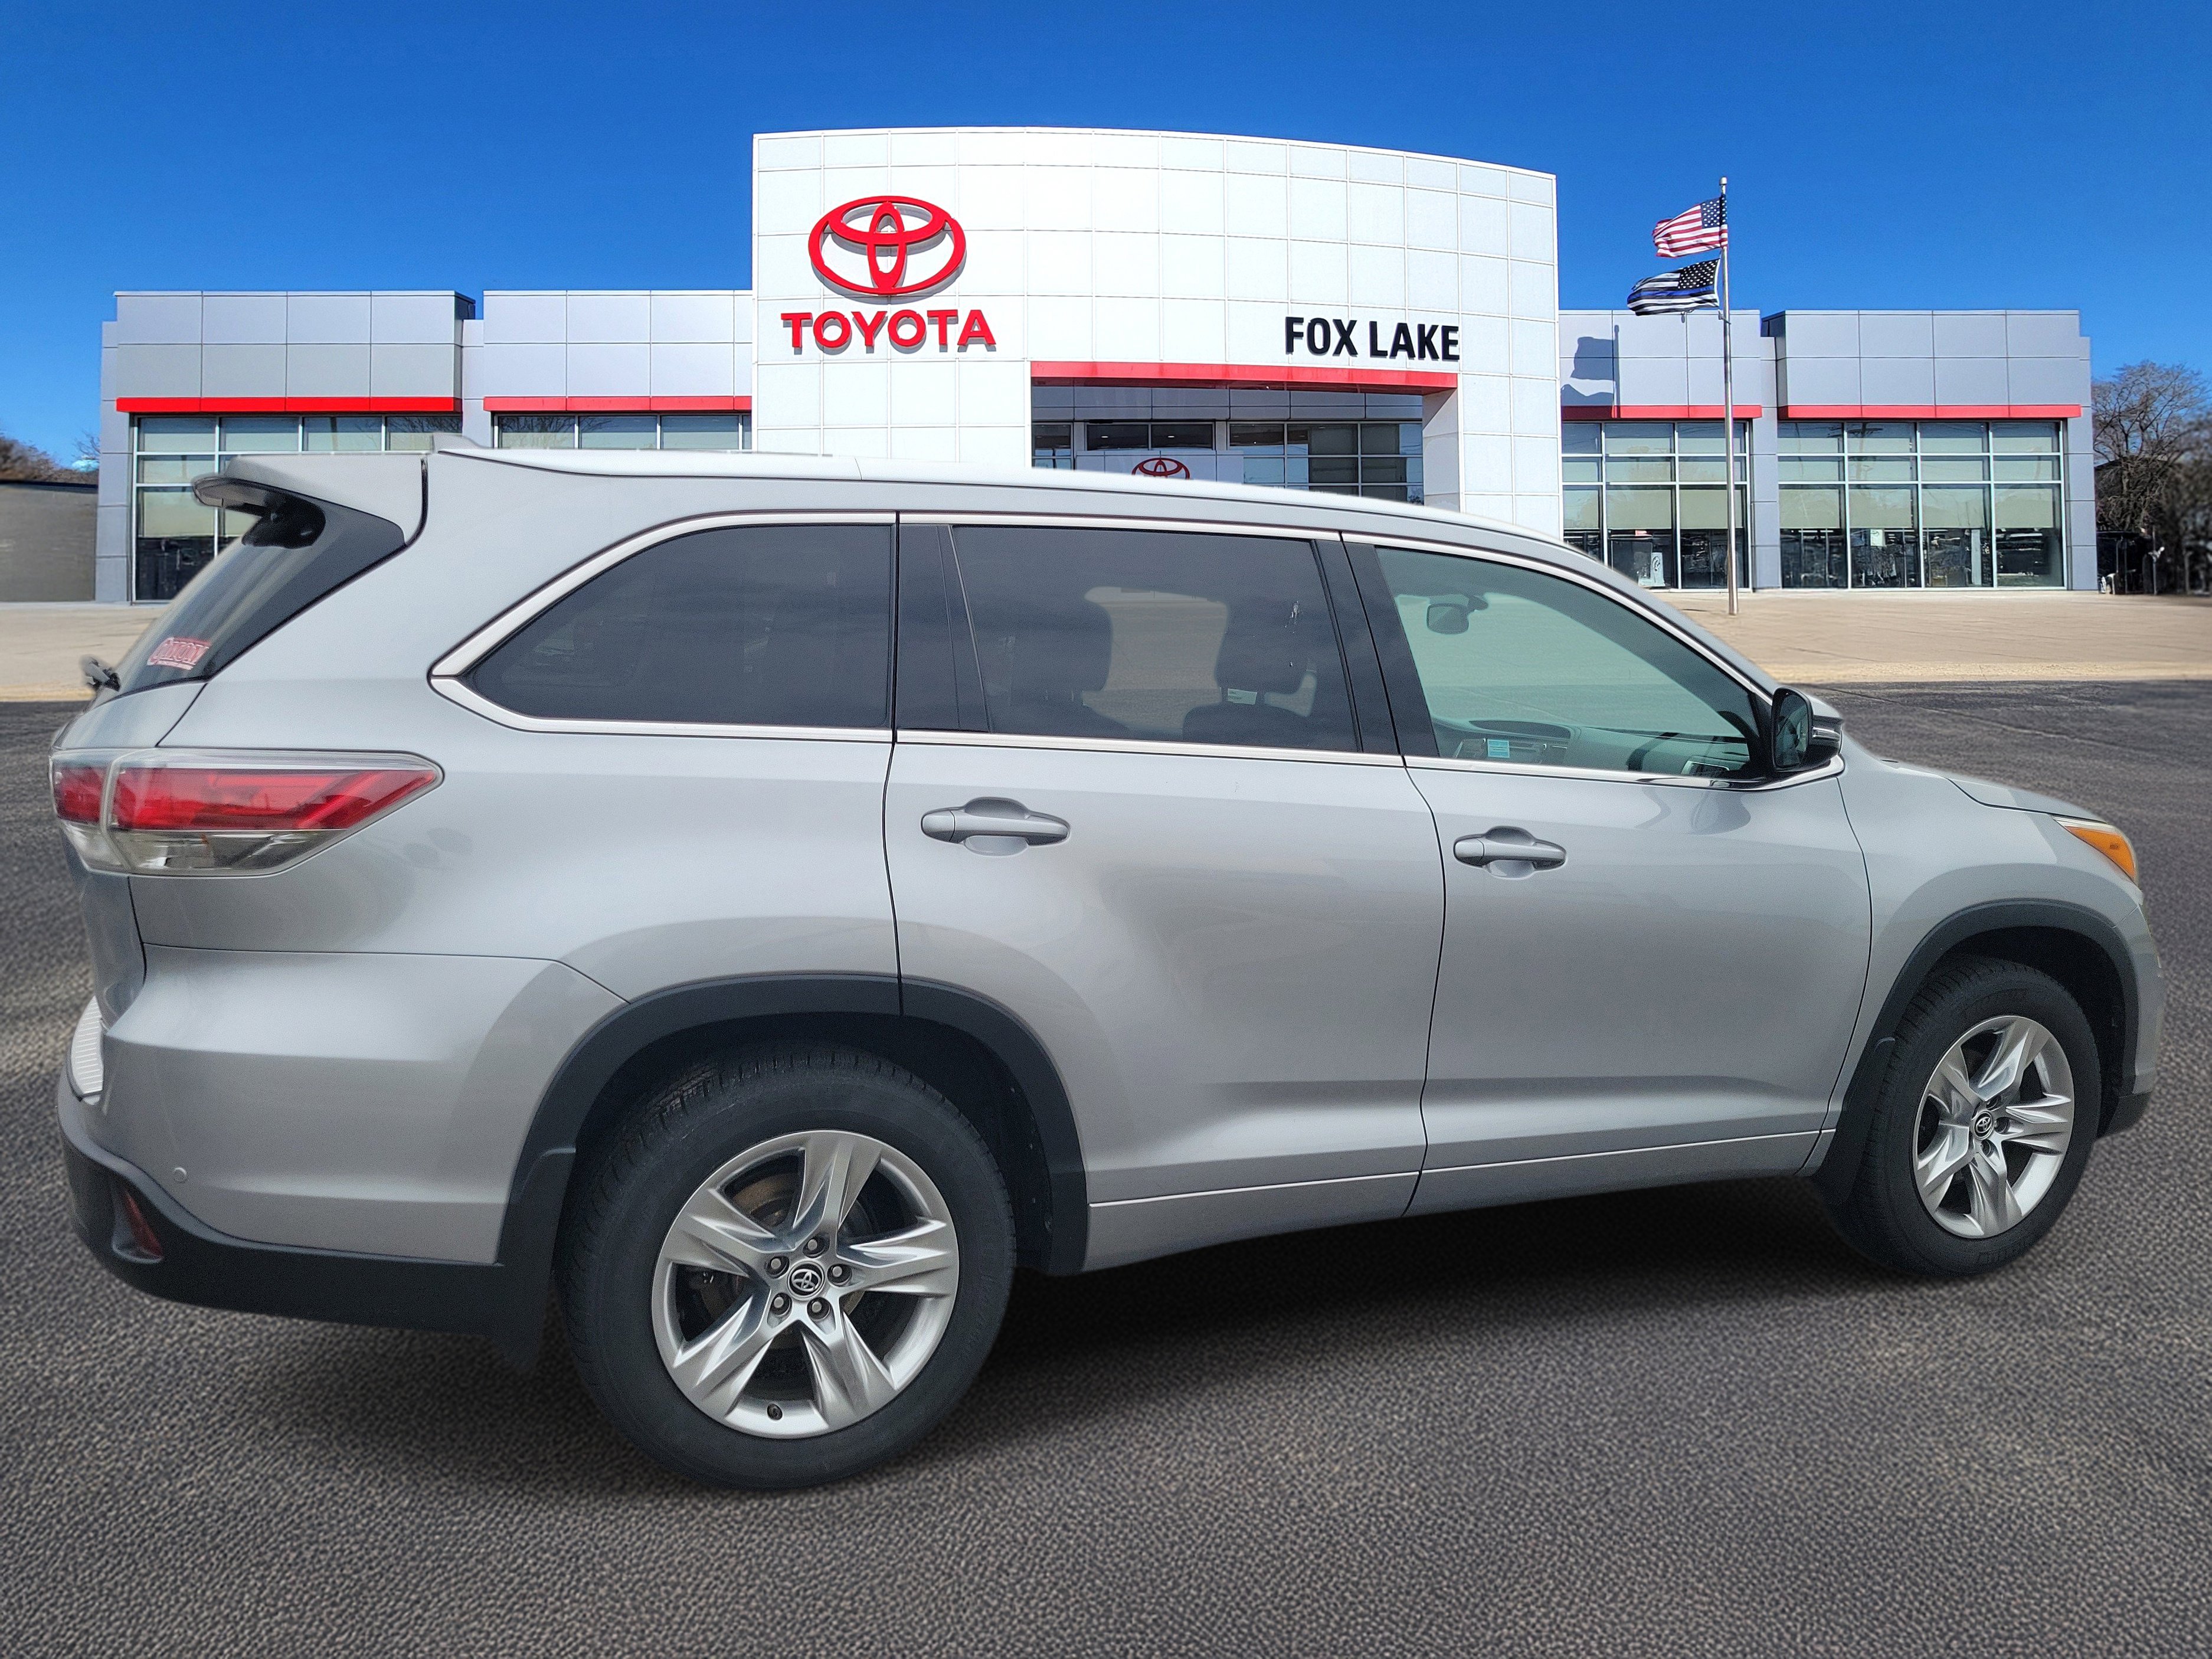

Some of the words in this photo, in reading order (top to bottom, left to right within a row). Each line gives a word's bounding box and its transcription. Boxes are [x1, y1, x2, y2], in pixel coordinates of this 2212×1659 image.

[781, 309, 996, 349] TOYOTA
[1285, 316, 1357, 356] FOX
[1369, 320, 1460, 361] LAKE
